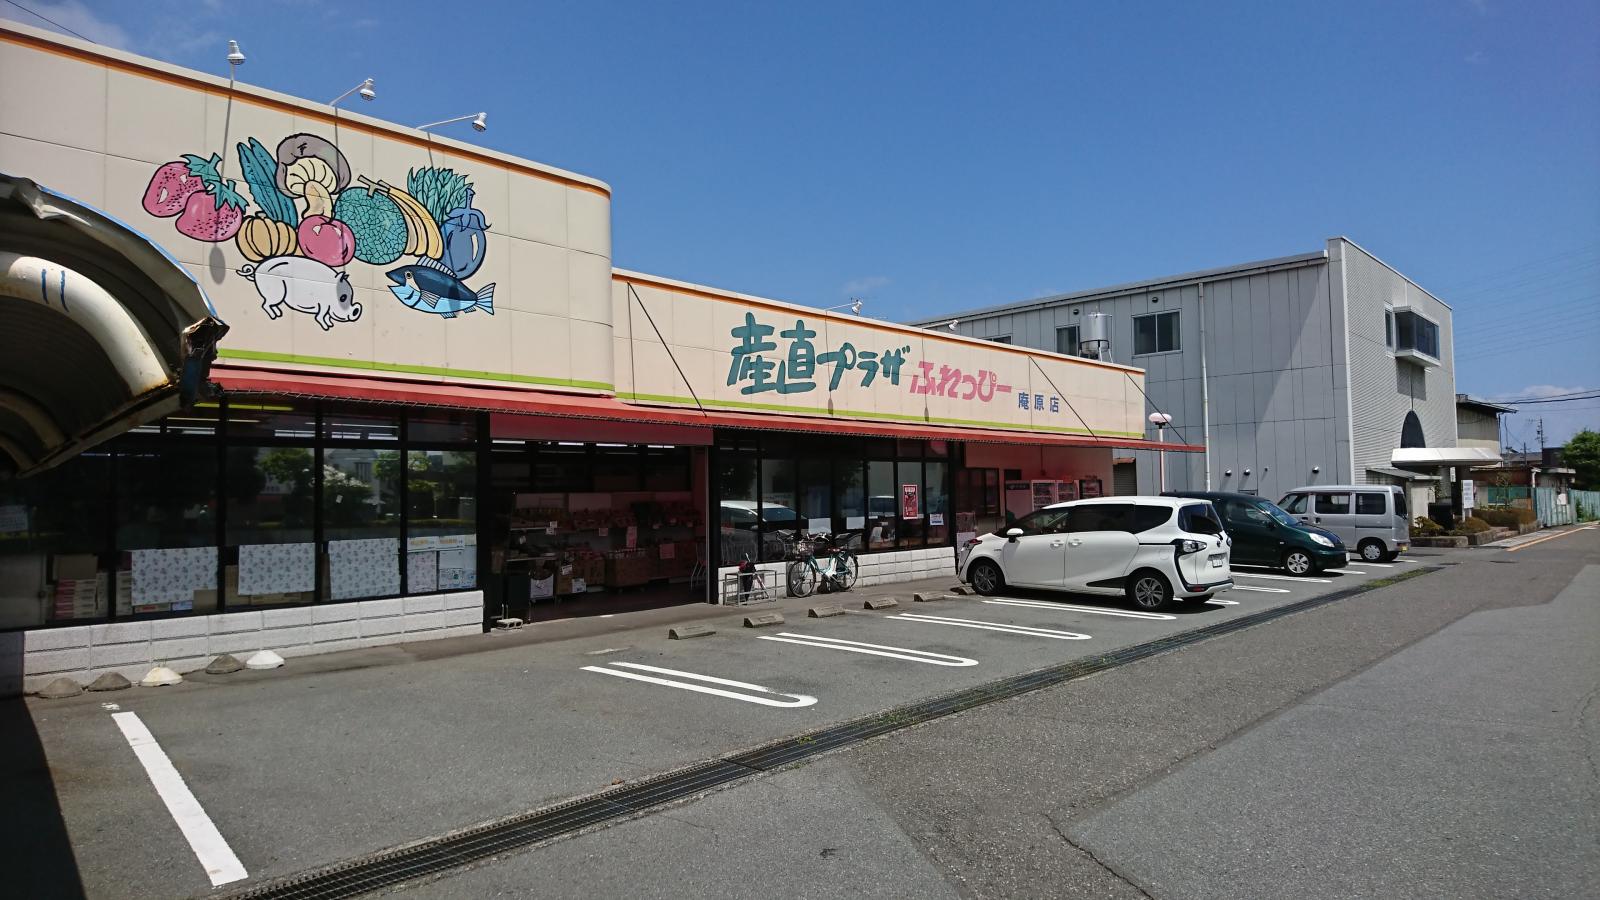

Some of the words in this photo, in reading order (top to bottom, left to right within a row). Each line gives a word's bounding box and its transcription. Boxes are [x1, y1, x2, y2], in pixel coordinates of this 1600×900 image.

[727, 311, 910, 395] 産直プラザ
[910, 361, 1012, 402] ふれっぴー
[1018, 391, 1060, 413] 庵原店
